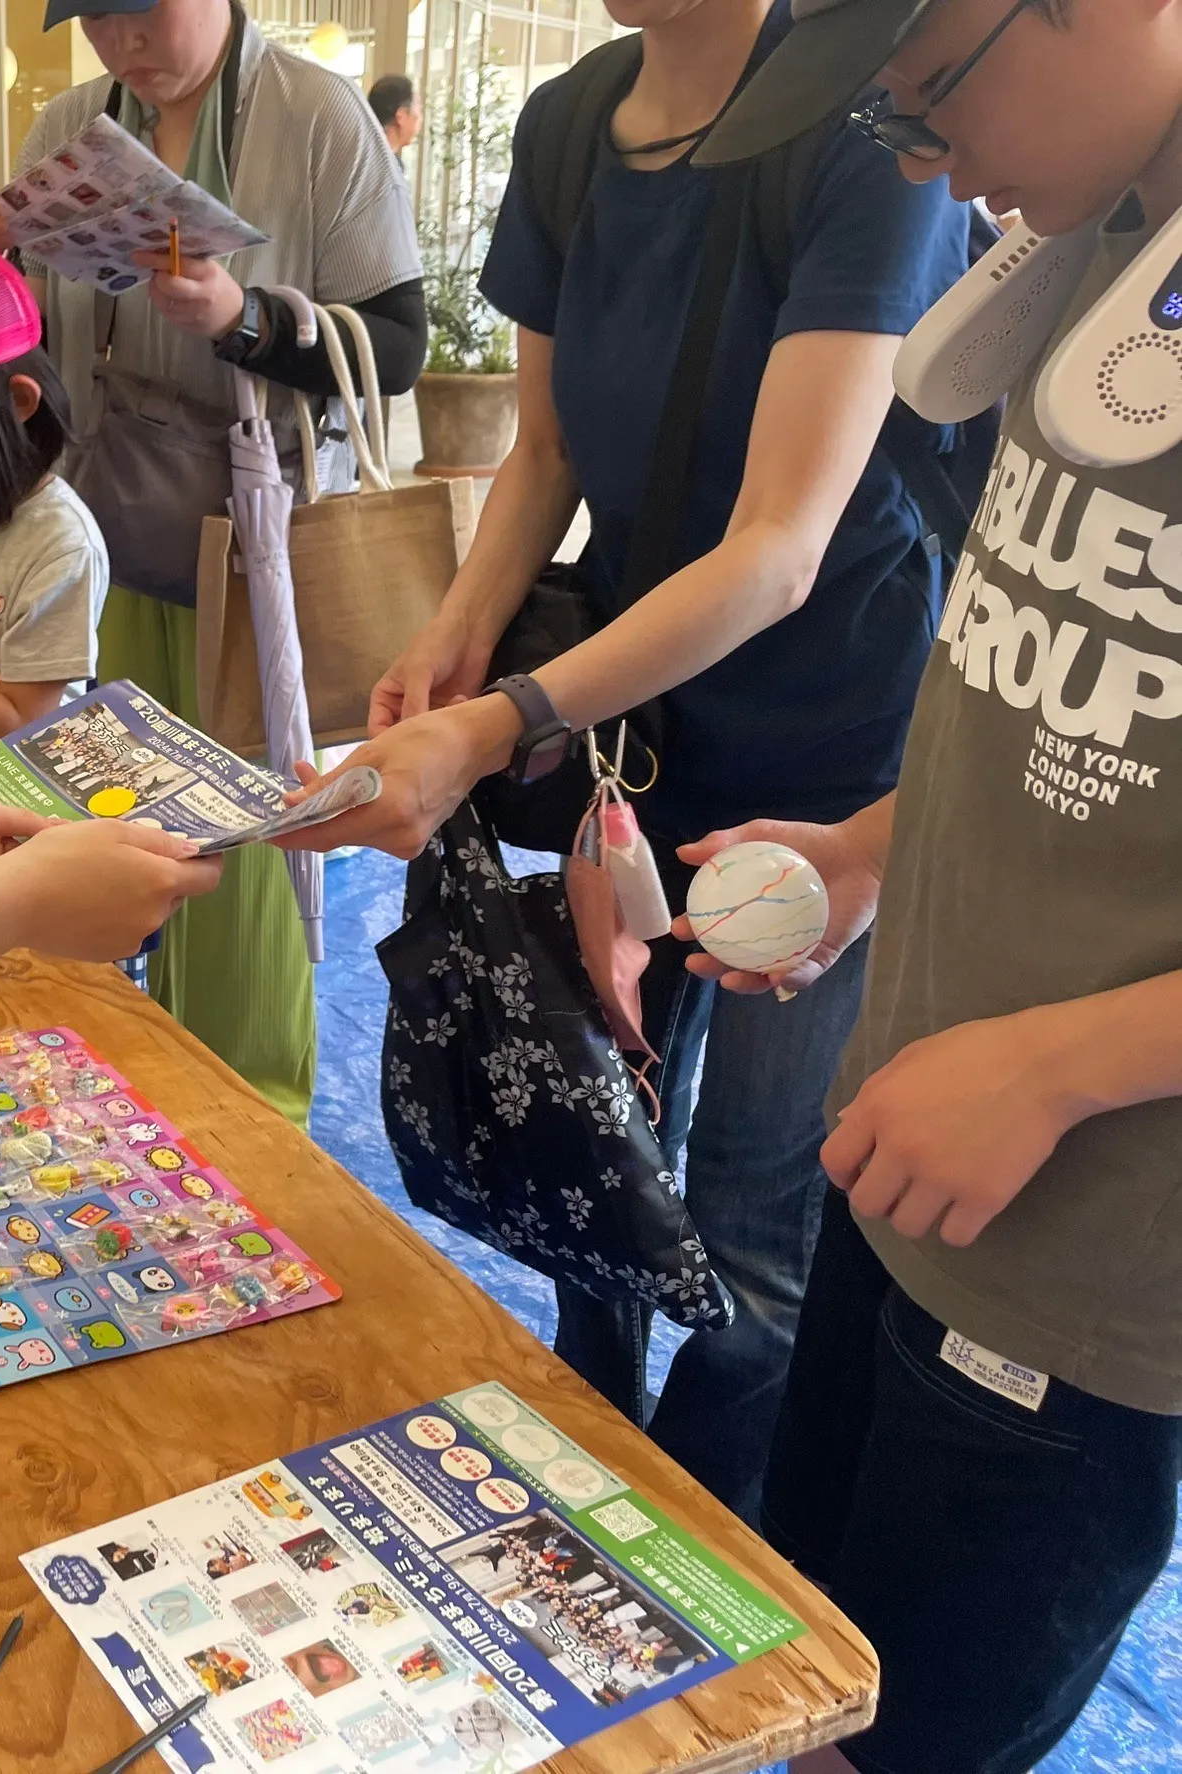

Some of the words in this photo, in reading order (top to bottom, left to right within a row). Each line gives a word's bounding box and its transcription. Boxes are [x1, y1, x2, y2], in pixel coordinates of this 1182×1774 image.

[1028, 747, 1121, 806] LONDON
[1033, 724, 1078, 764] NEW
[1083, 746, 1161, 789] YORK
[1024, 771, 1090, 822] TOKYO
[973, 1368, 997, 1386] GREAT
[976, 1360, 988, 1373] WE
[988, 1367, 1006, 1381] CAN
[1024, 1382, 1039, 1396] THE
[438, 1572, 520, 1645] 2024年7月19日
[692, 1607, 736, 1640] LINE
[121, 1663, 191, 1734] 座一覧
